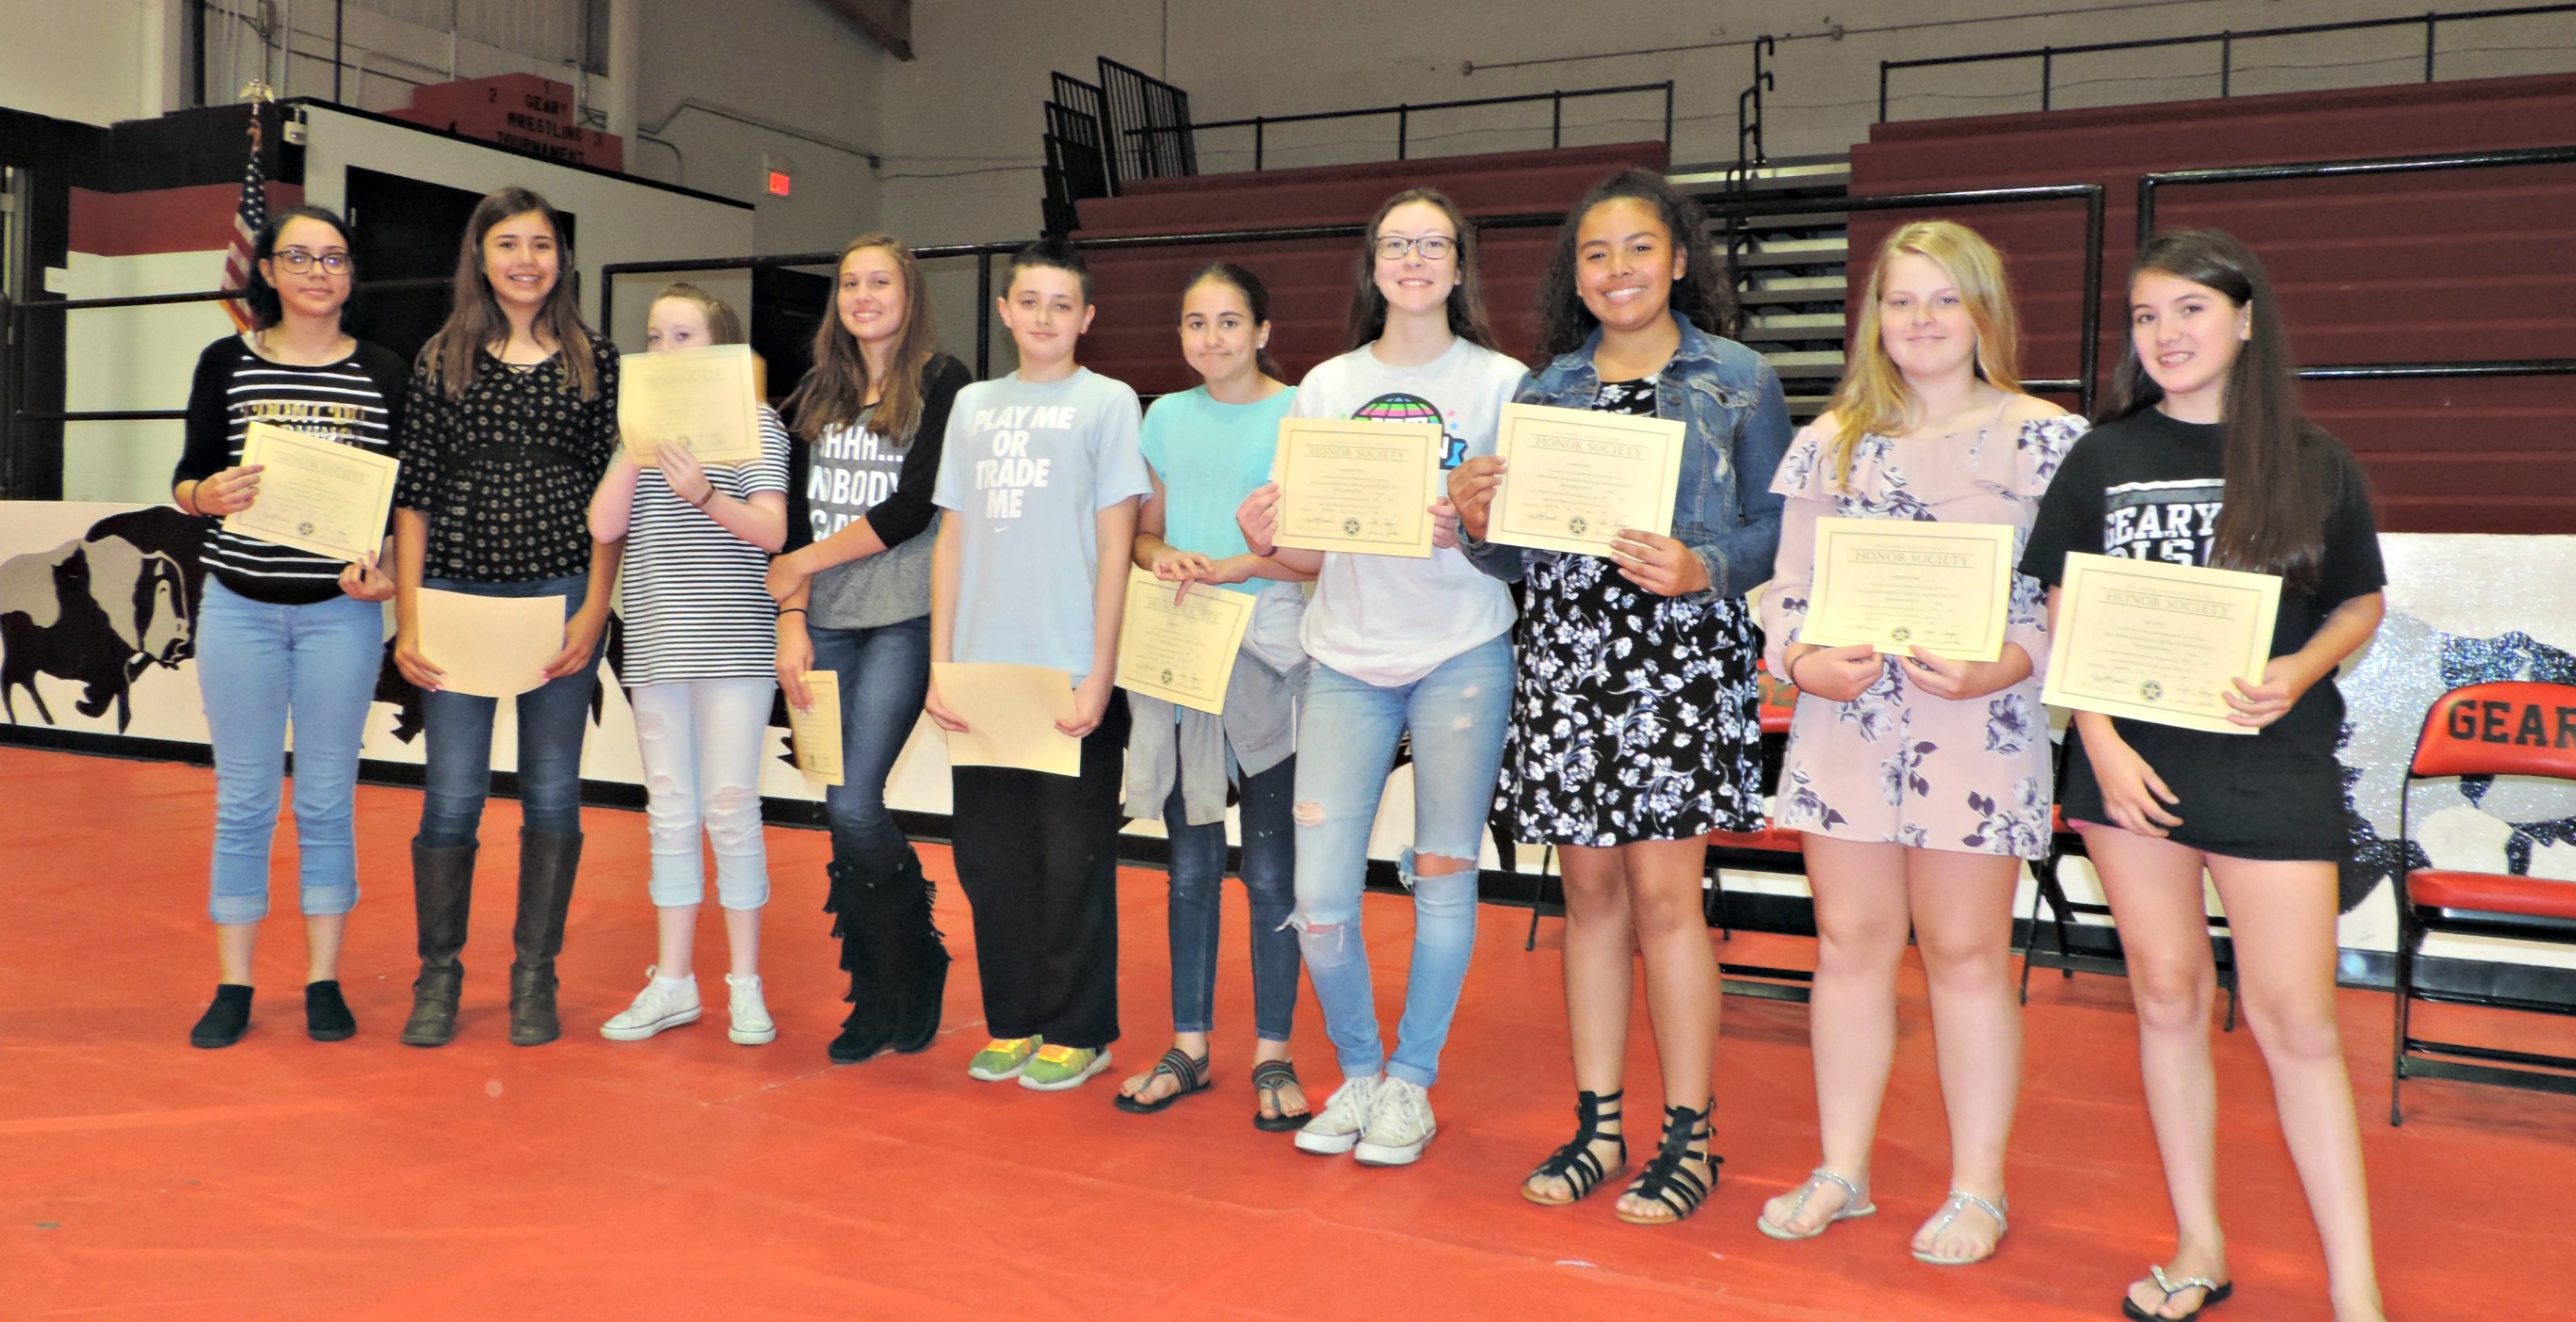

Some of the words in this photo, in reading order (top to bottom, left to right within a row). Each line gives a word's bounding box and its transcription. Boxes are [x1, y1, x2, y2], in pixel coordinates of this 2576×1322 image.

[489, 88, 498, 103] 2
[524, 94, 568, 114] GEARY
[507, 112, 583, 142] WRESTLING
[972, 406, 1033, 437] PLAY
[1029, 406, 1076, 430] ME
[992, 429, 1030, 458] OR
[1310, 446, 1352, 458] HONOR
[1356, 449, 1404, 460] SOCIETY
[1536, 437, 1584, 451] HONOR
[1587, 443, 1643, 458] SOCIETY
[976, 458, 1051, 490] TRADE
[986, 489, 1024, 519] ME
[2103, 502, 2224, 551] GEARY
[1856, 550, 1907, 563] HONOR
[1910, 553, 1969, 566] SOCIETY
[2107, 590, 2161, 607] HONOR
[2166, 600, 2230, 617] SOCIETY
[2449, 700, 2576, 749] GEAR
